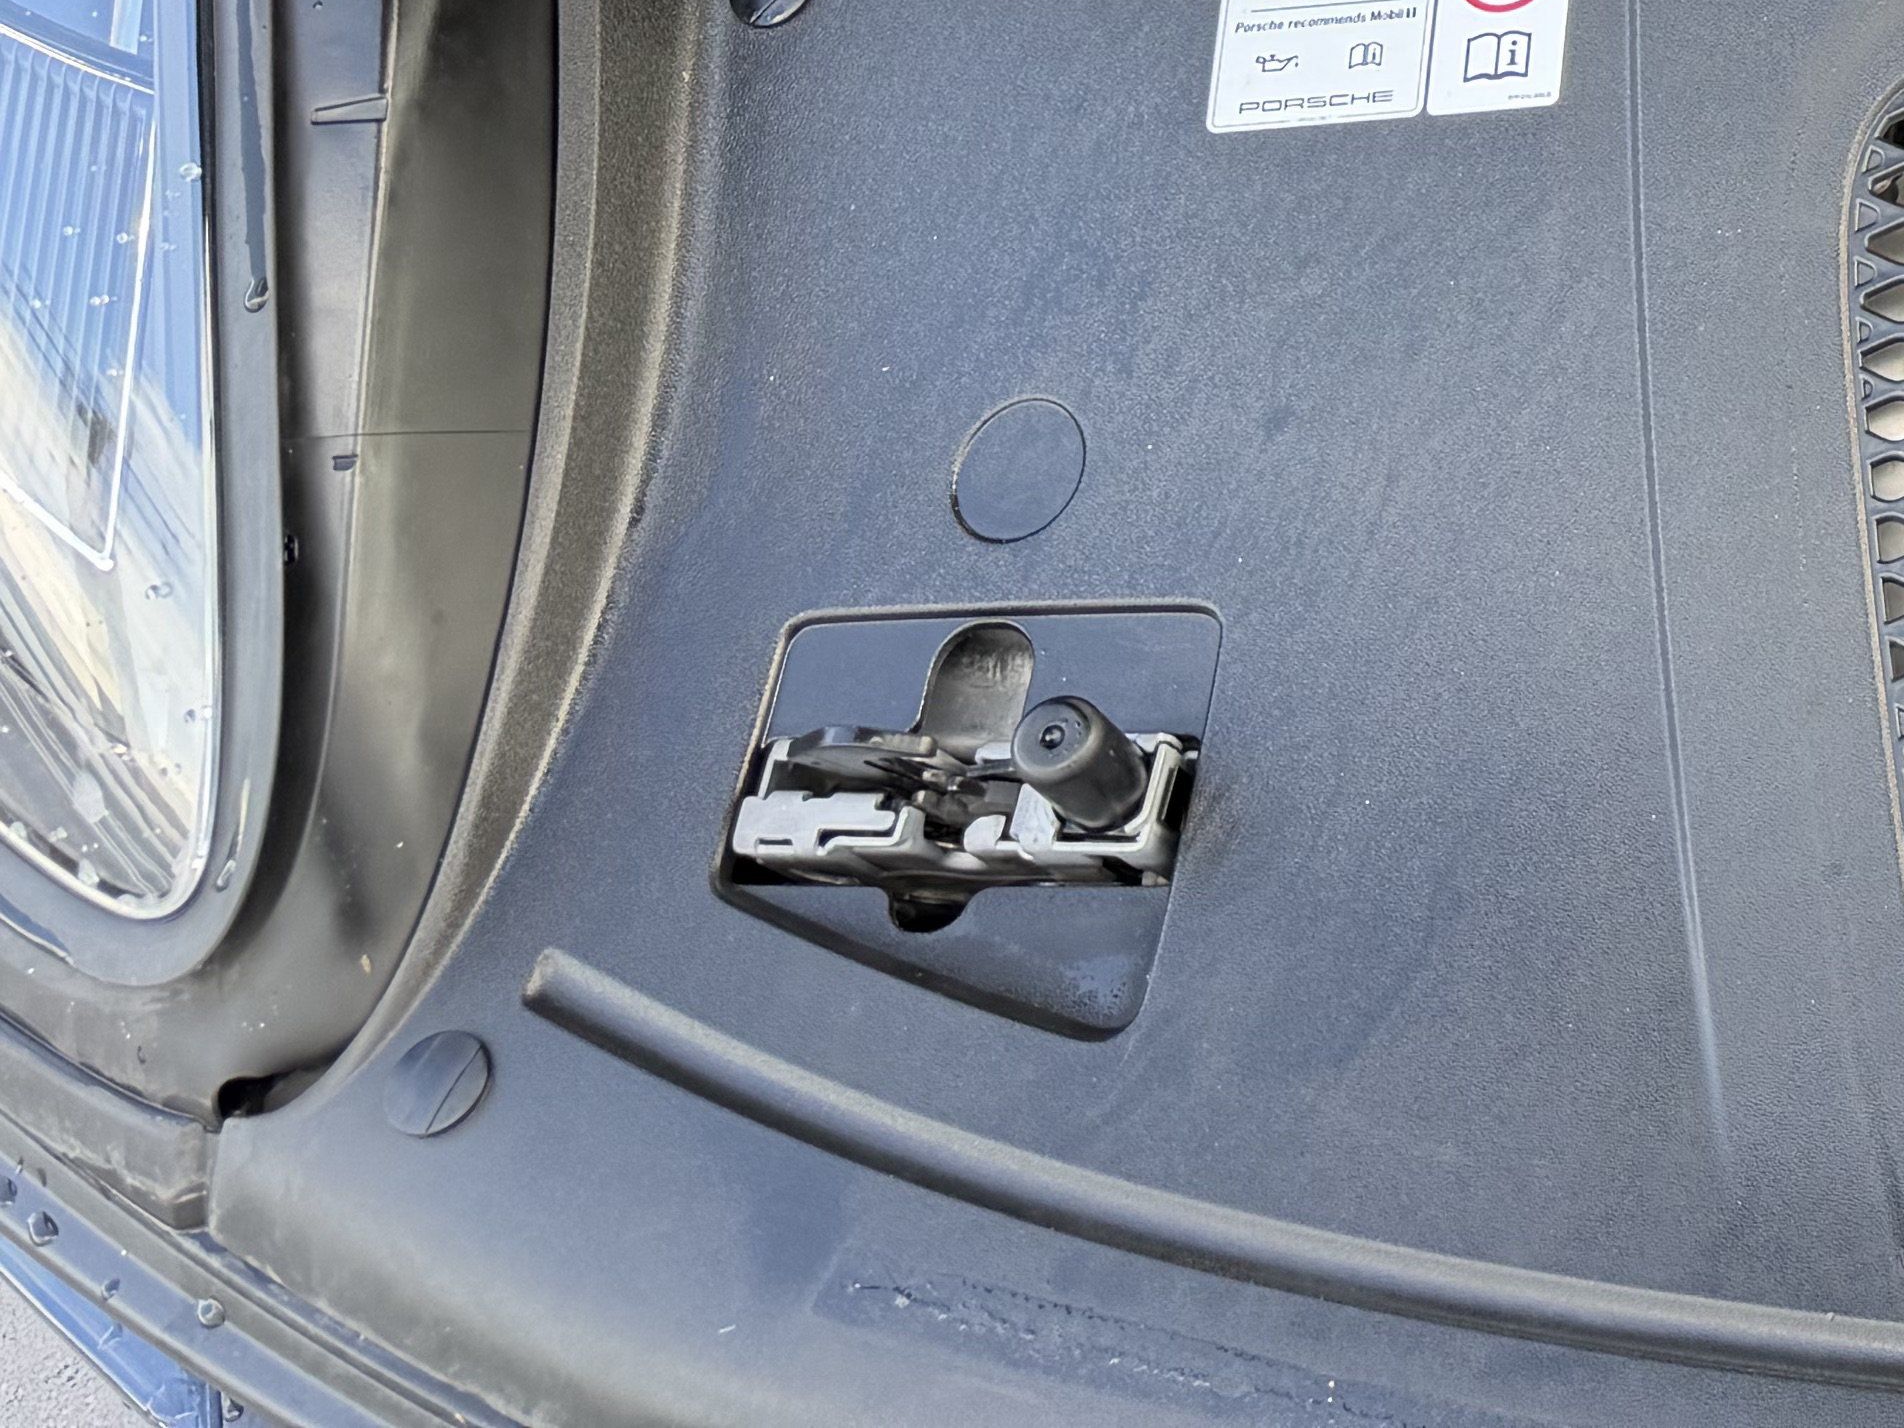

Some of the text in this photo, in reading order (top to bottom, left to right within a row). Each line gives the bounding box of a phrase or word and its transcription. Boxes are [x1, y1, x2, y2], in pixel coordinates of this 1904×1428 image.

[1234, 20, 1285, 34] Porsche
[1288, 13, 1367, 29] recommends
[1370, 10, 1404, 23] Mobil
[1238, 89, 1395, 115] PORSCHE
